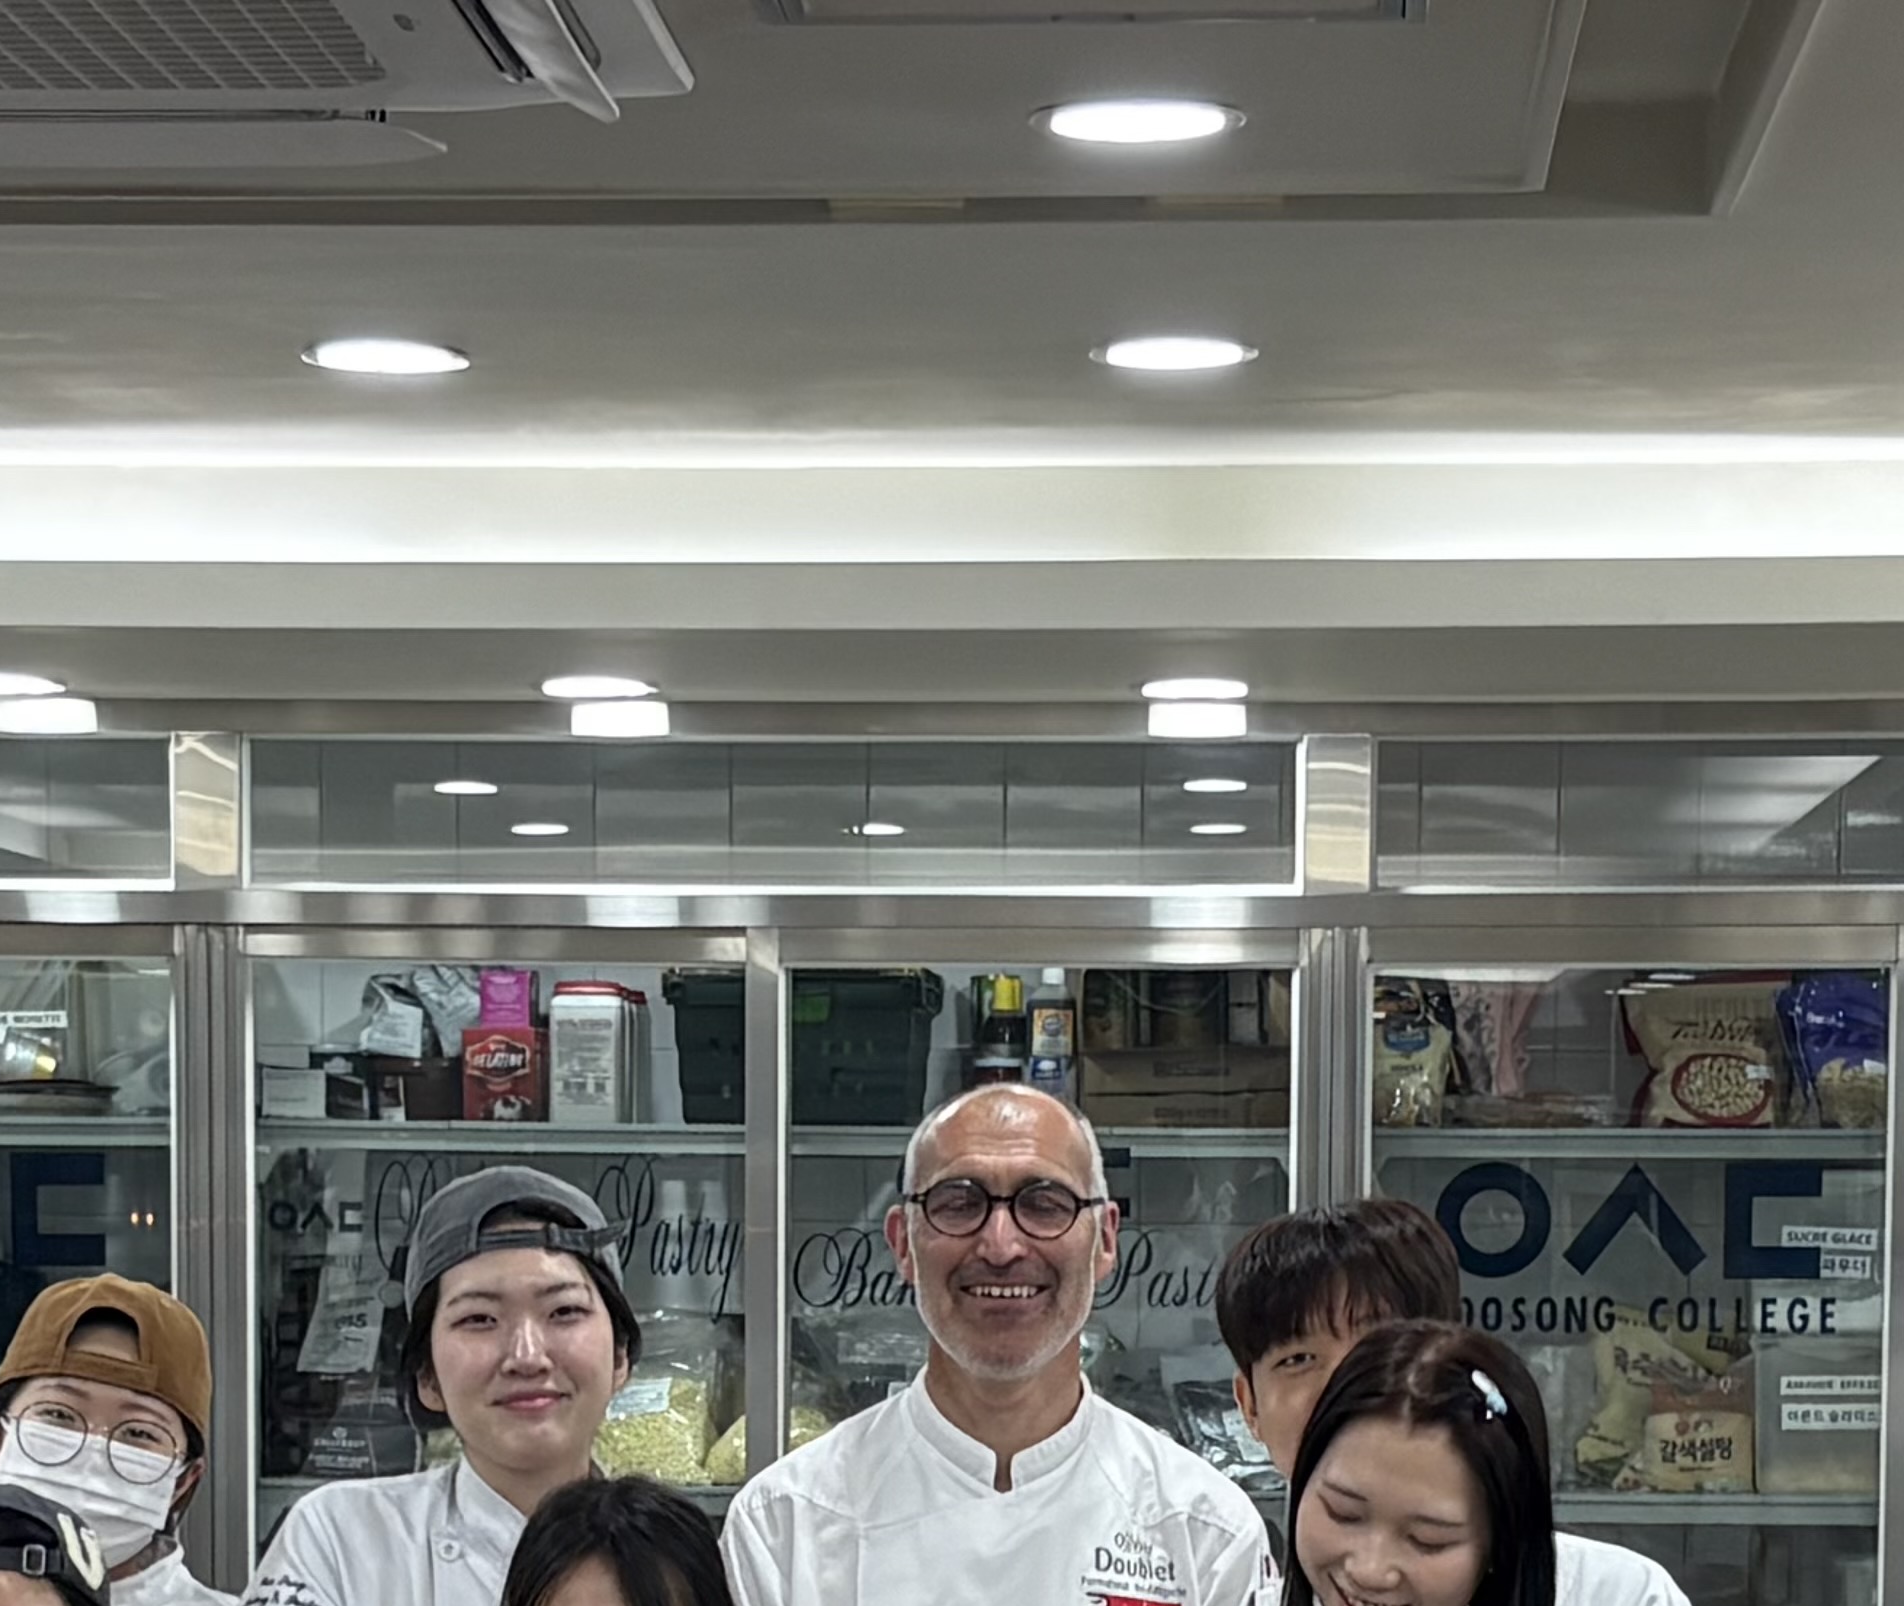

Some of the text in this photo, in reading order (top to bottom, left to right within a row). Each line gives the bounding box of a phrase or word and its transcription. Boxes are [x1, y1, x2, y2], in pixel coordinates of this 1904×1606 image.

[1831, 1232, 1872, 1245] GLACE
[1096, 1228, 1217, 1309] Past
[1462, 1296, 1838, 1334] OSONG COLLEGE
[1659, 1437, 1733, 1464] 갈색설탕
[1094, 1546, 1176, 1582] Doublet
